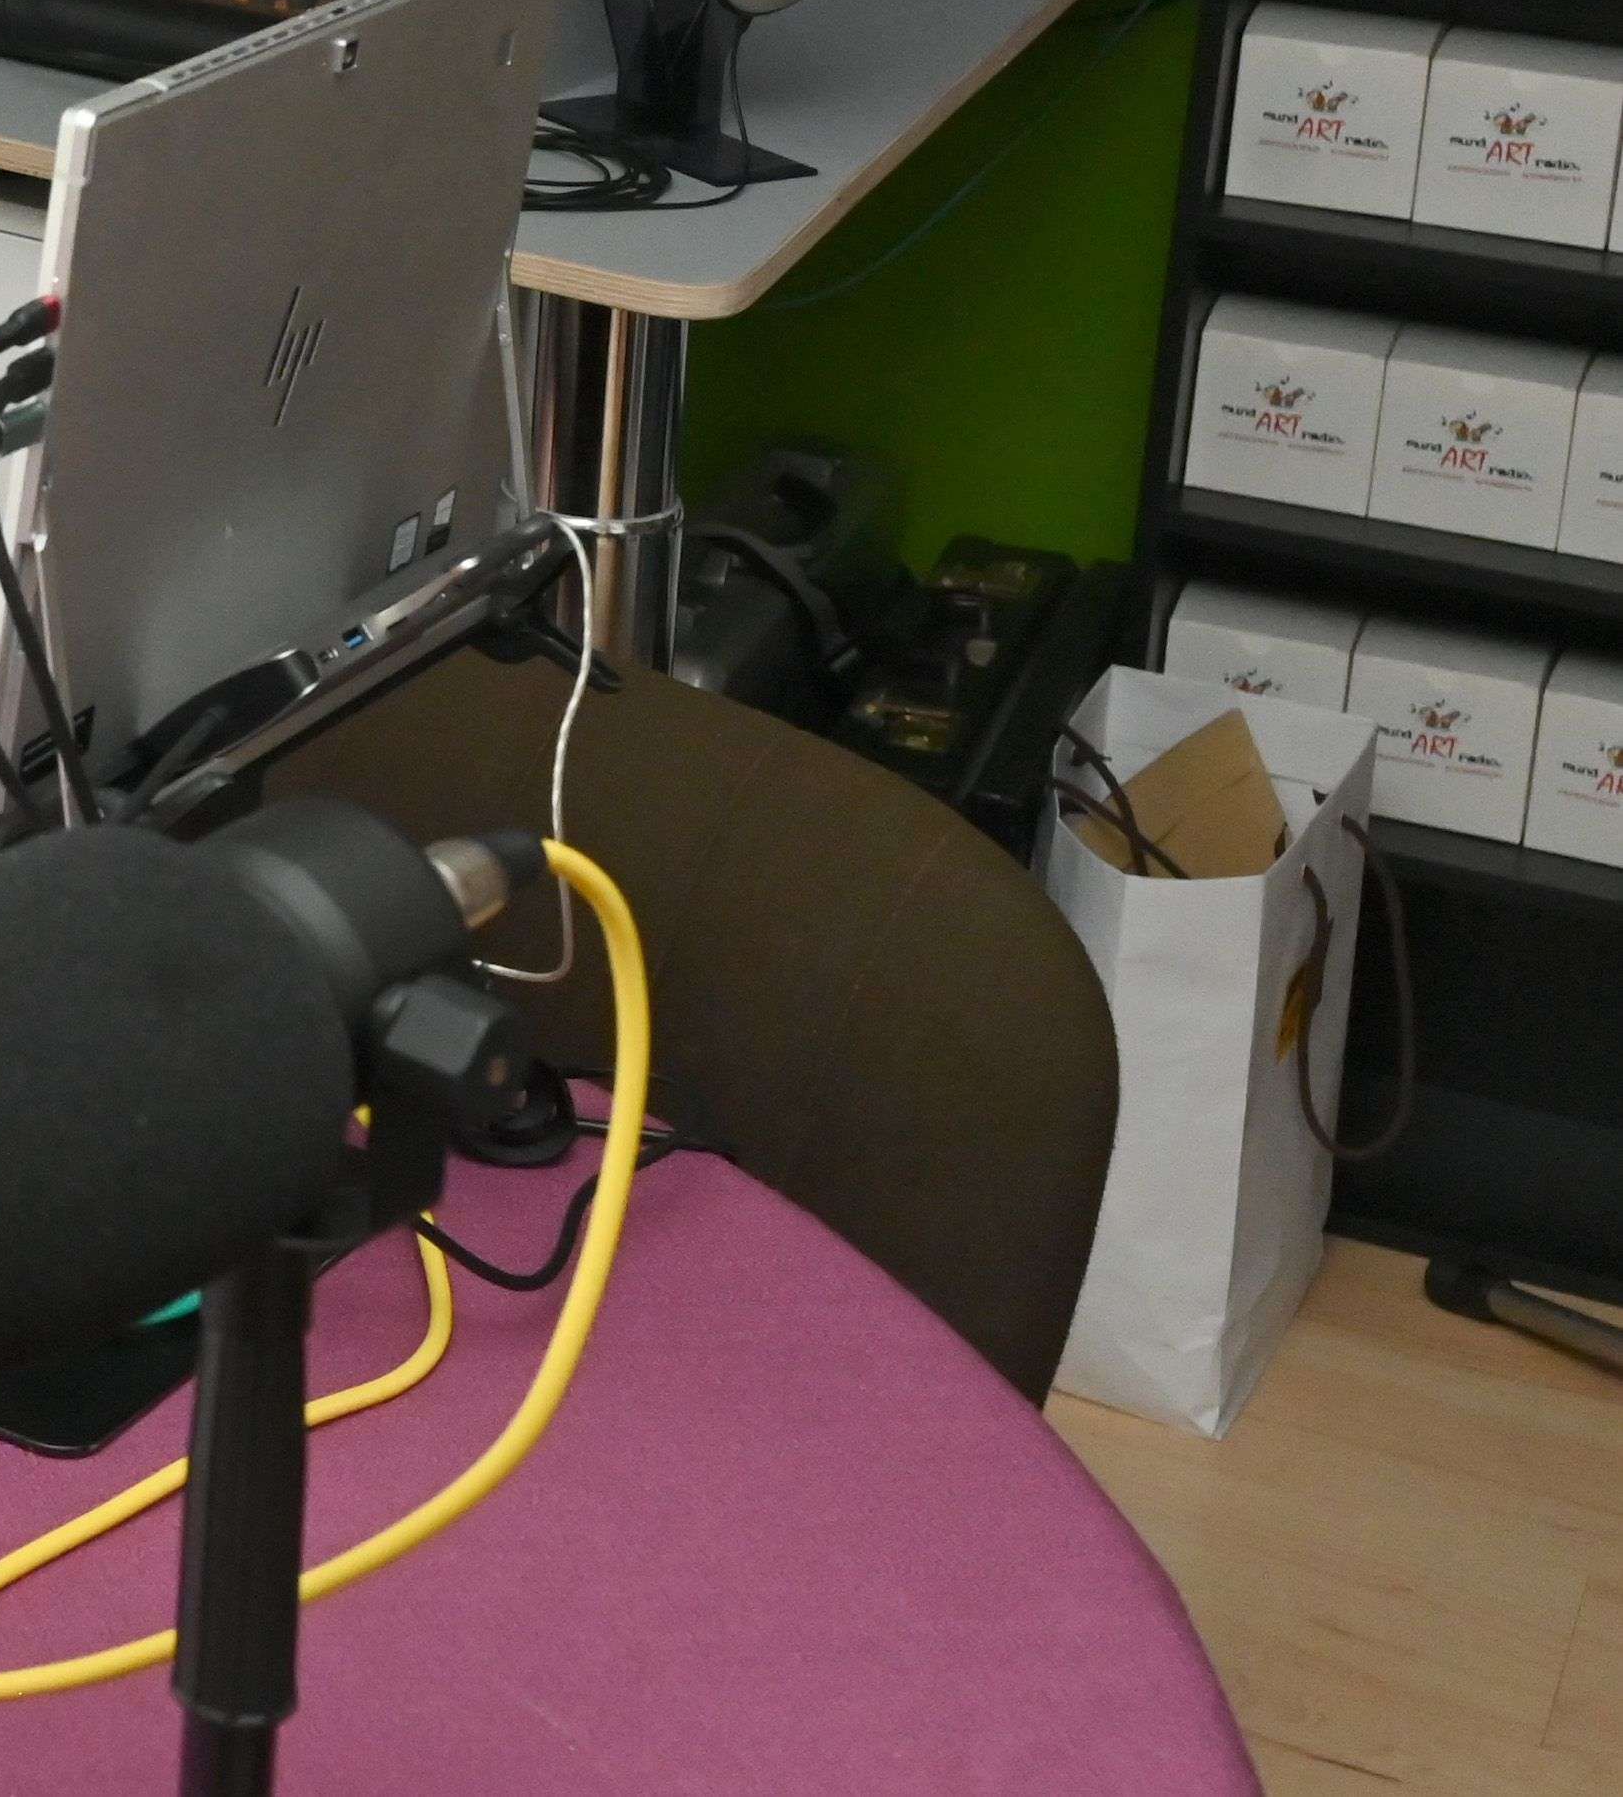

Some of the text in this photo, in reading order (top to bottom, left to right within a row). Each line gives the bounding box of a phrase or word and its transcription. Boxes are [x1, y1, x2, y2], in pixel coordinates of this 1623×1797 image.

[1297, 116, 1347, 143] ART
[1485, 141, 1535, 166] ART
[1255, 410, 1303, 440] ART
[1440, 445, 1490, 474] ART
[1411, 734, 1460, 761] ART
